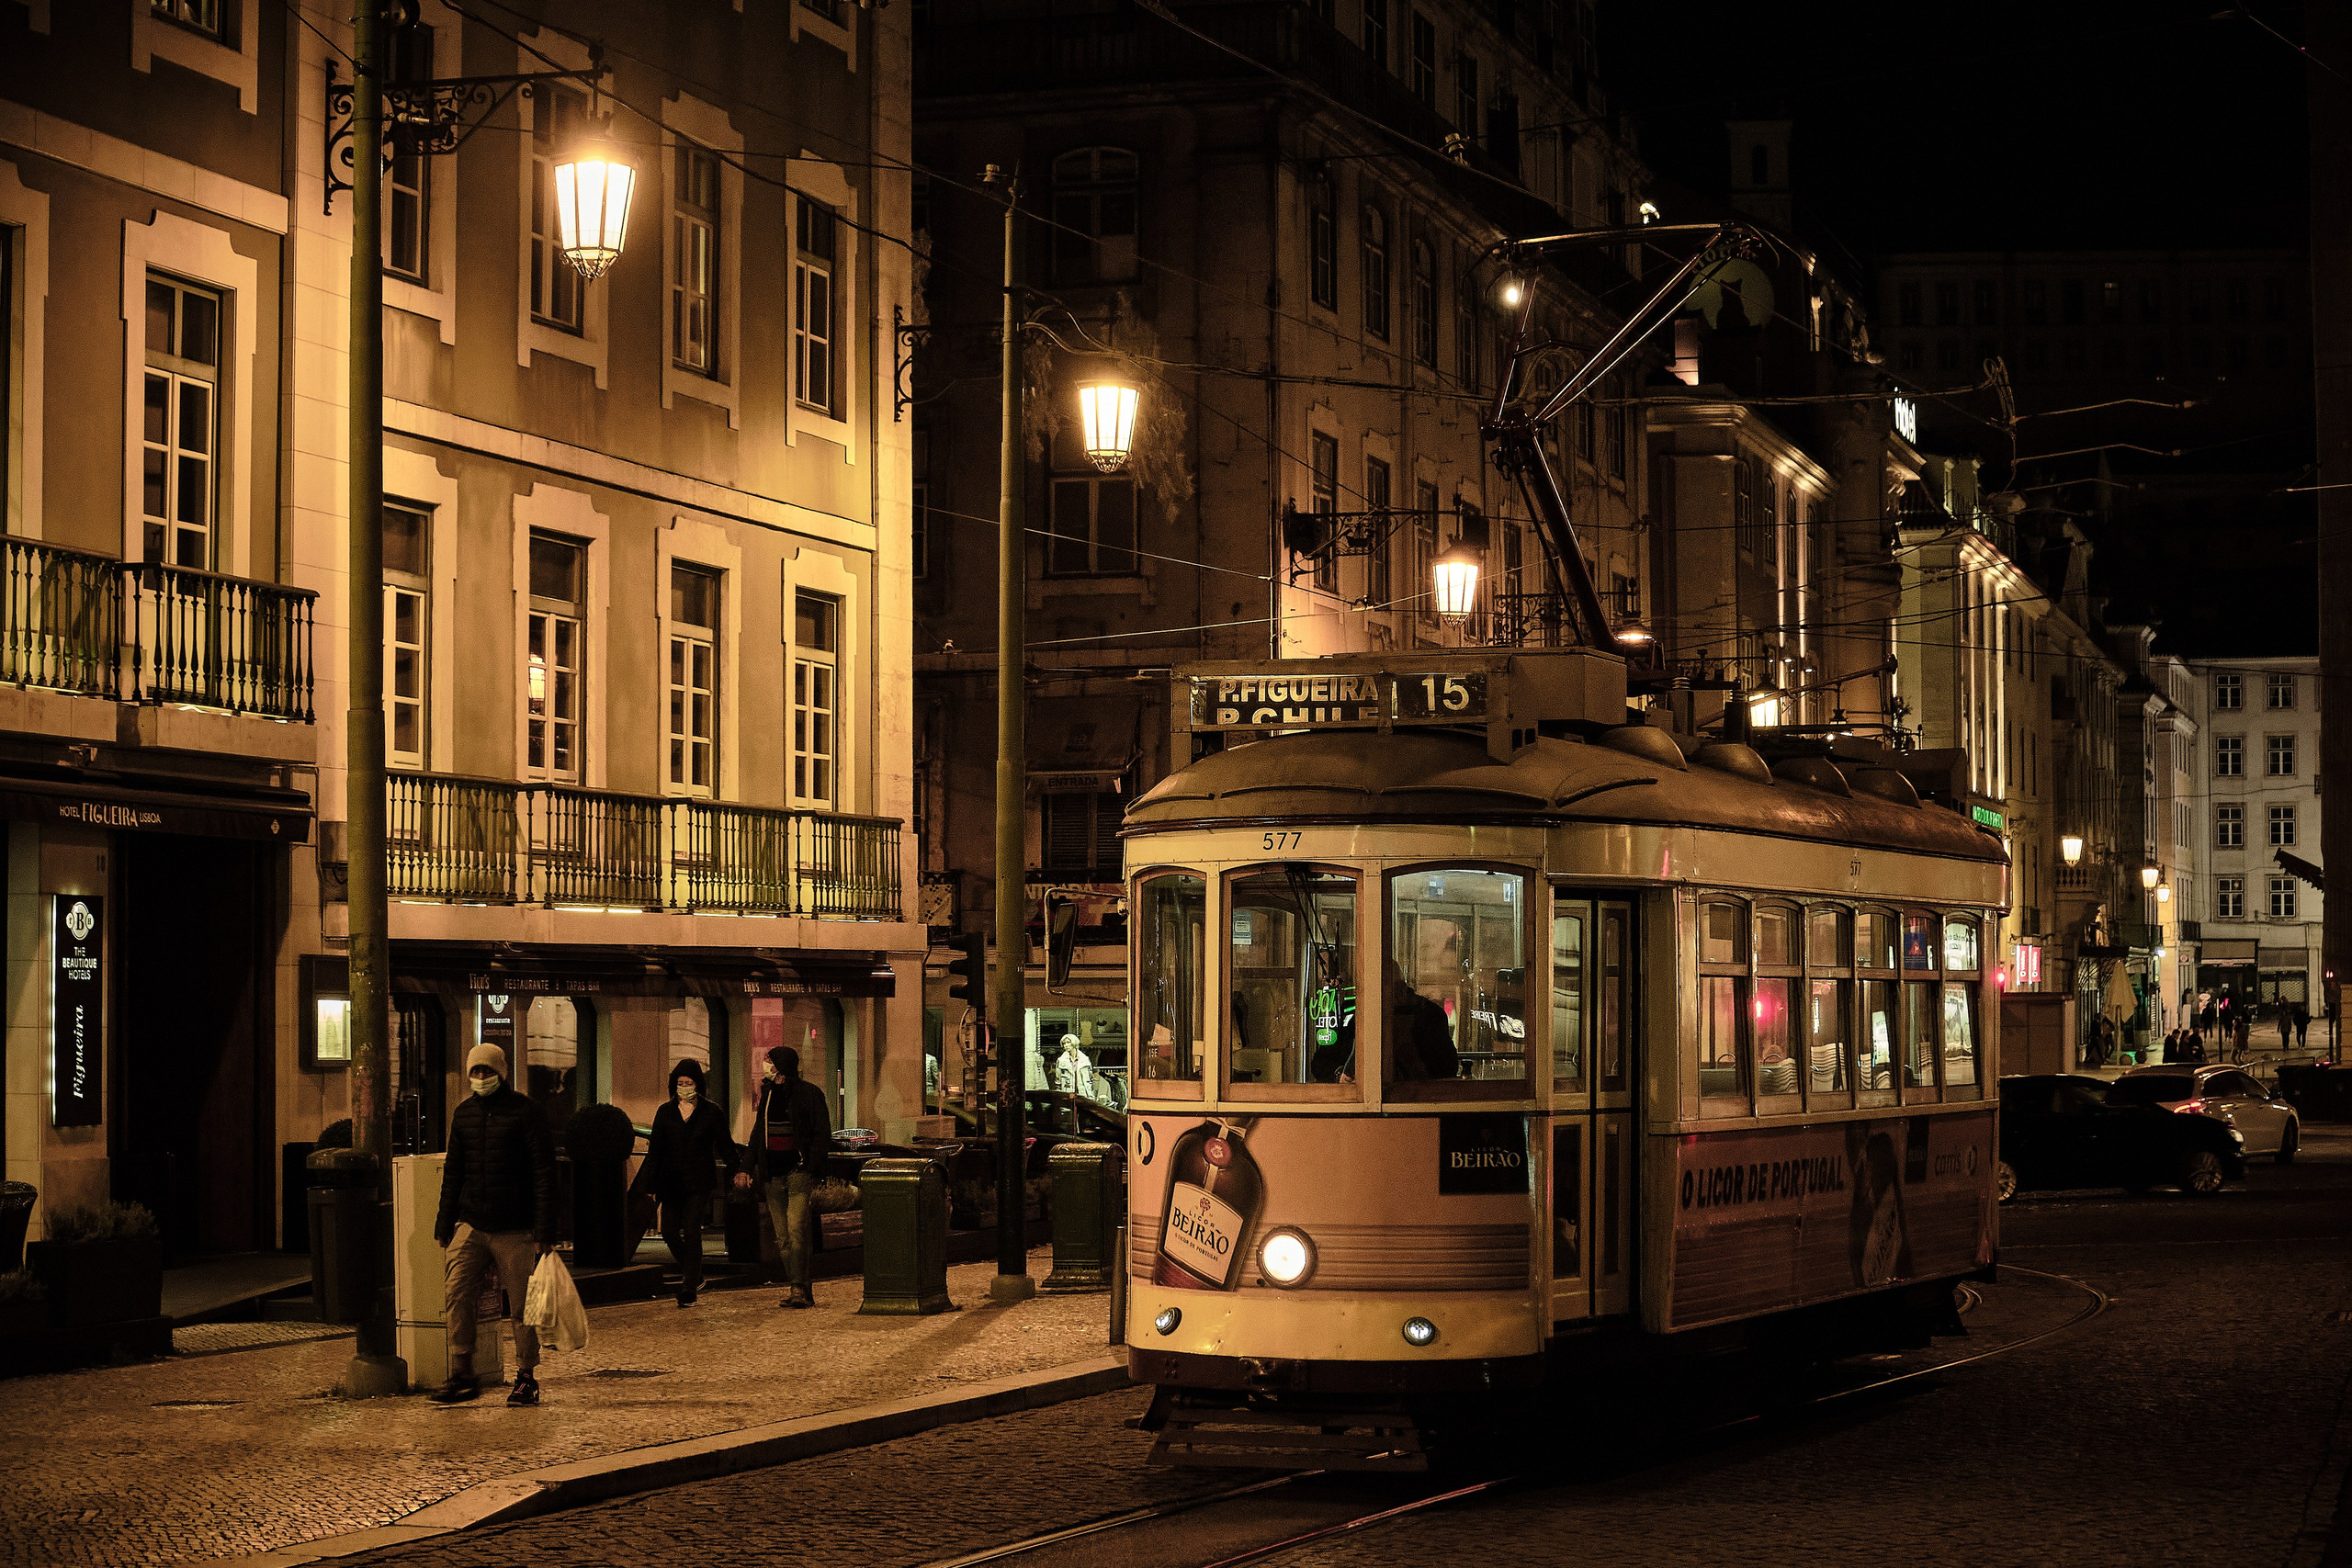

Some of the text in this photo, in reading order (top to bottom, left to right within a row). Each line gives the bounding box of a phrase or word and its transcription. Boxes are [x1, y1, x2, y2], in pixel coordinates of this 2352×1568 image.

[1218, 677, 1378, 703] P.FIGUEIRA
[1421, 674, 1470, 712] 15
[1047, 777, 1099, 787] ENTRADA
[59, 802, 162, 827] HOTEL FIGUEIRA LISBOA
[1262, 832, 1303, 851] 577
[1850, 861, 1861, 876] 577
[74, 946, 86, 957] THE
[62, 957, 97, 969] BEAUTIQUE
[68, 969, 92, 981] HOTELS
[504, 978, 549, 991] RESTAURANTE
[566, 980, 585, 991] TAPAS
[588, 980, 601, 991] BAR
[73, 1003, 86, 1100] Figueira
[1450, 1149, 1521, 1168] BEIRÃO
[1682, 1156, 1844, 1210] O LICOR DE PORTUGAL
[1189, 1210, 1216, 1228] LICOR
[1172, 1206, 1229, 1255] BEIRÃO
